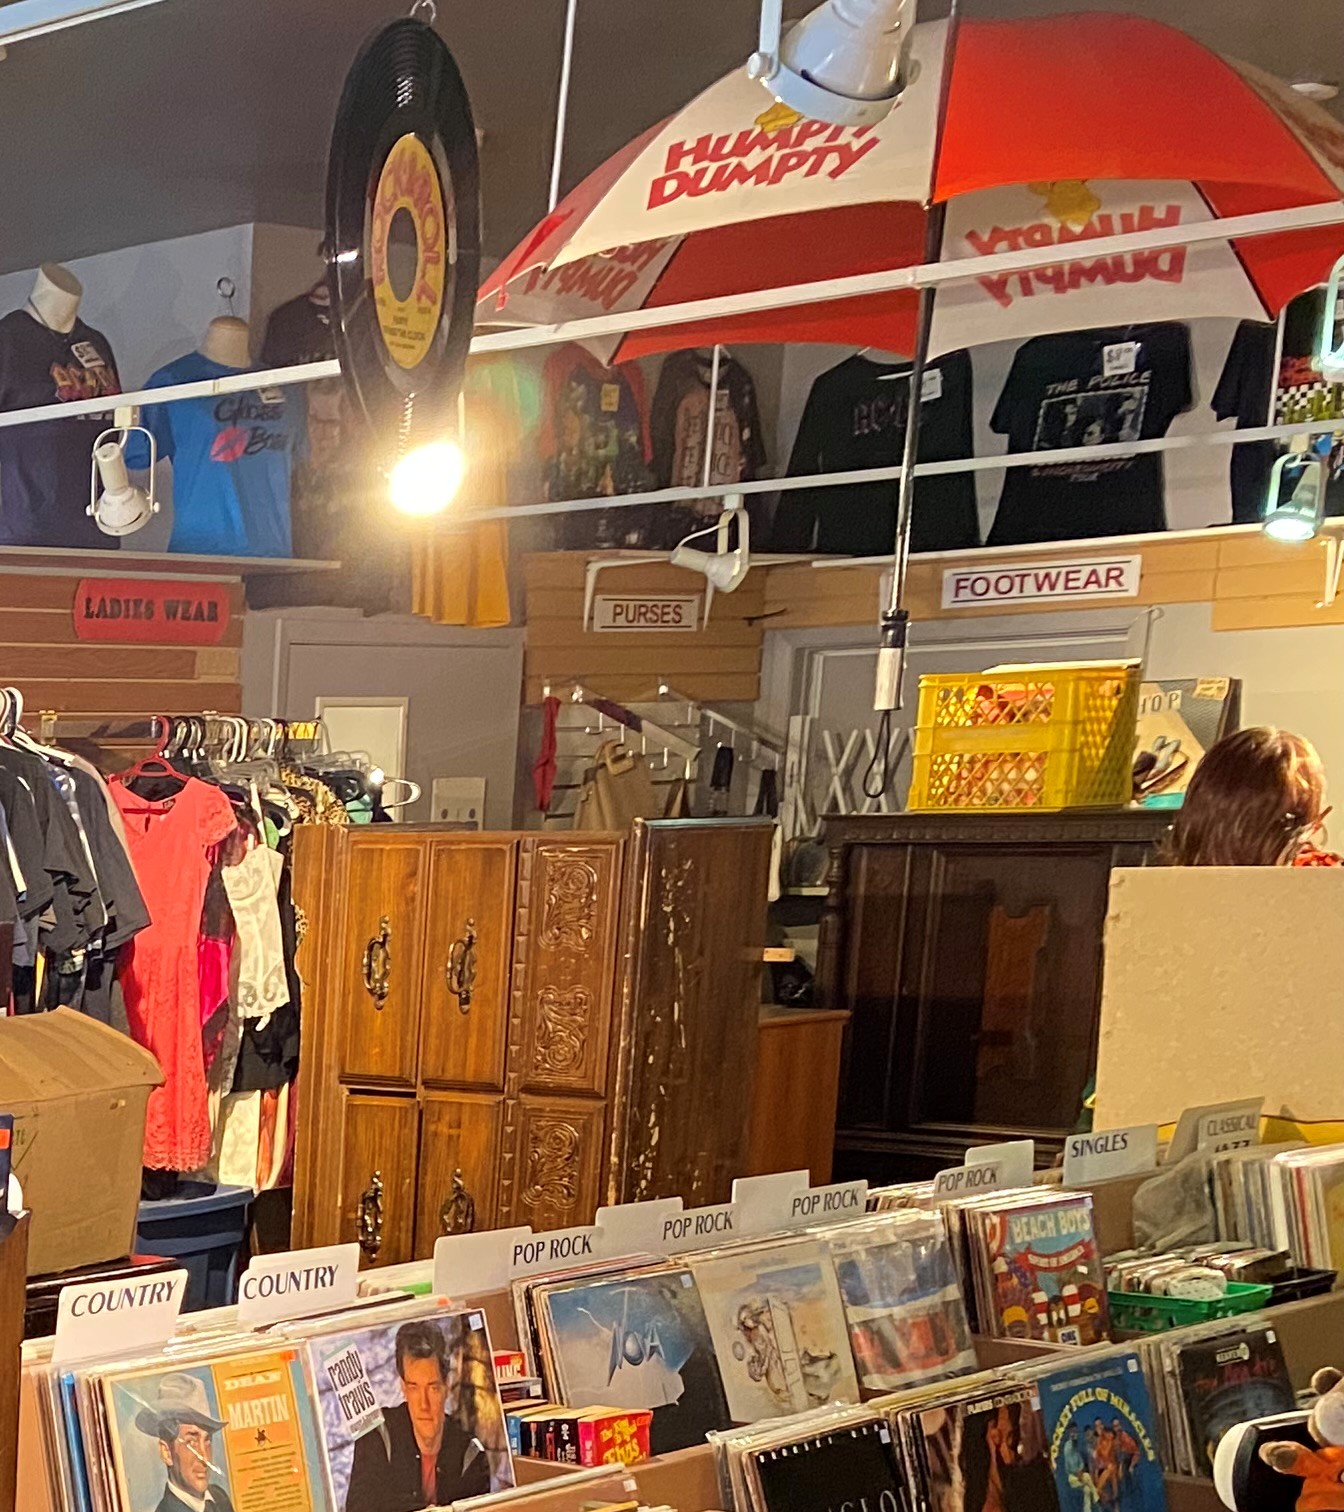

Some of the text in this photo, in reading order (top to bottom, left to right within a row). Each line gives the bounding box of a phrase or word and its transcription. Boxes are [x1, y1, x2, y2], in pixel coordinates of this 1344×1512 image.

[647, 137, 882, 211] DUMPTY
[1045, 370, 1152, 396] THE POLICE
[953, 566, 1126, 598] FOOTWEAR
[164, 598, 220, 623] WEAR
[612, 603, 684, 625] PURSES
[1206, 1113, 1257, 1138] CLASSICAL
[1070, 1132, 1128, 1159] SINGLES
[937, 1166, 999, 1193] POP ROCK
[791, 1189, 860, 1218] POP ROCK
[663, 1210, 734, 1241] POP ROCK
[1013, 1207, 1092, 1243] BEACH BOYS
[512, 1233, 593, 1266] POP ROCK
[243, 1263, 340, 1300] COUNTRY
[70, 1279, 180, 1318] COUNTRY
[223, 1371, 281, 1391] DEAN
[328, 1347, 365, 1394] randy
[227, 1392, 291, 1432] MARTIN
[336, 1380, 378, 1424] travis
[1070, 1387, 1096, 1411] FULL
[1095, 1386, 1110, 1401] OF
